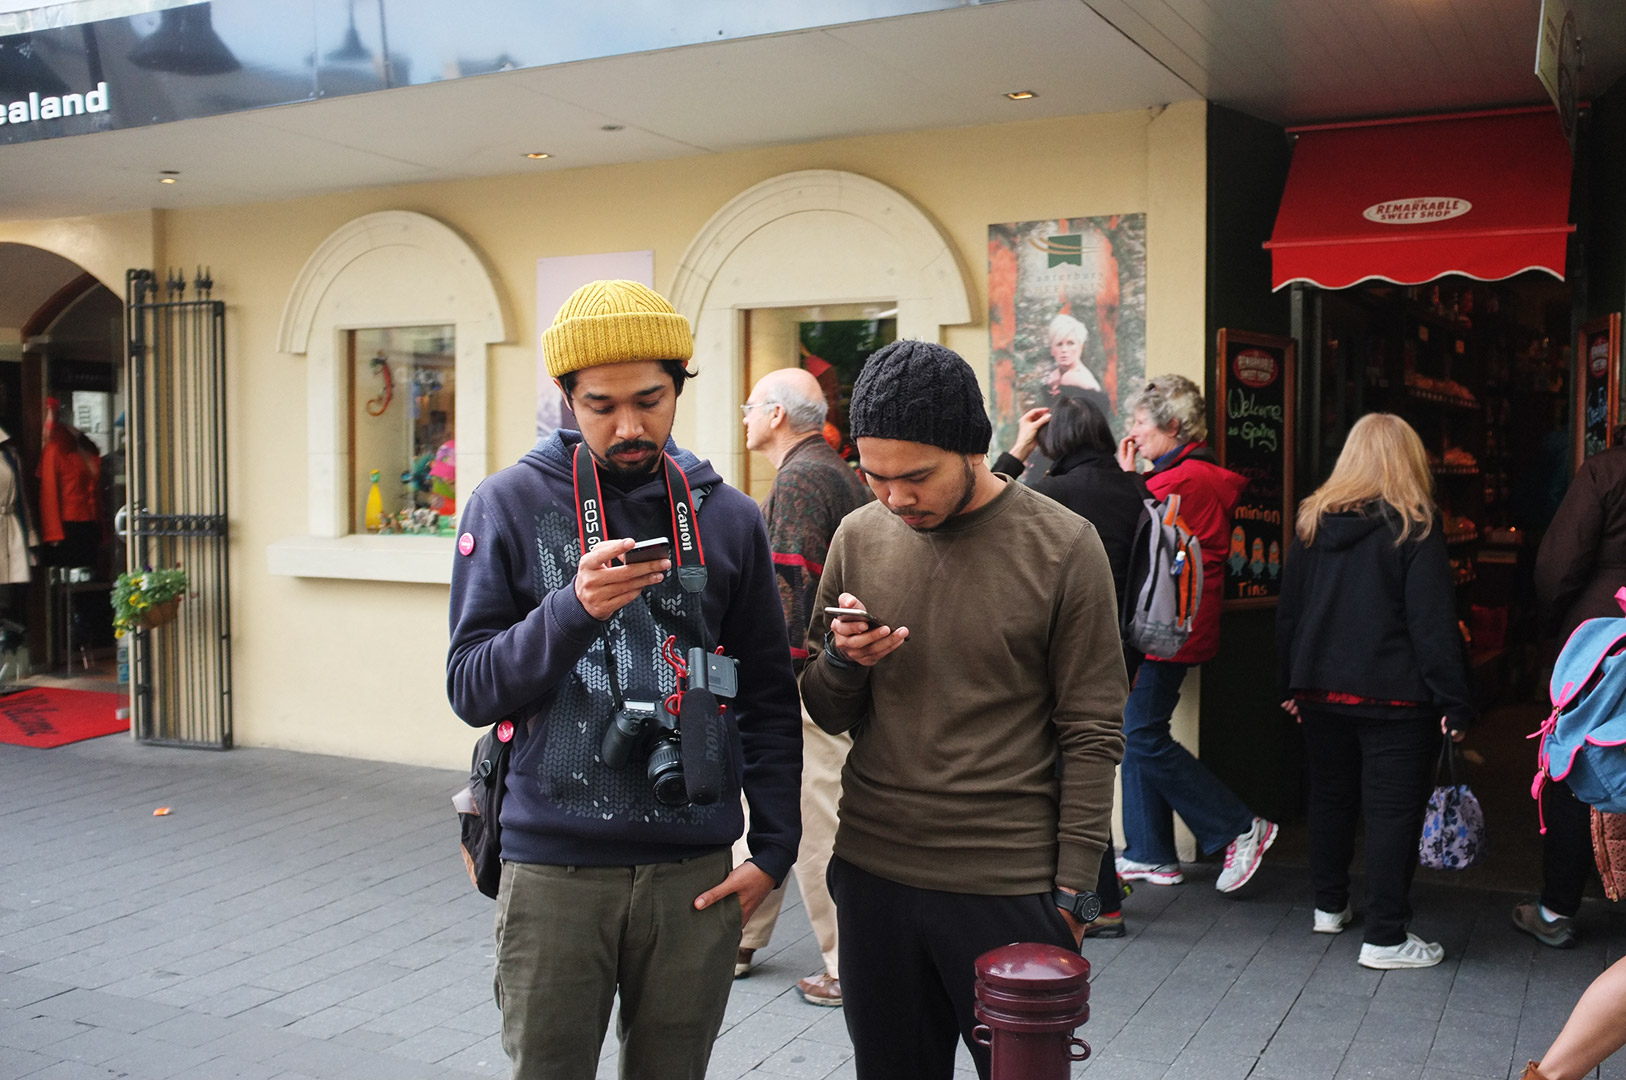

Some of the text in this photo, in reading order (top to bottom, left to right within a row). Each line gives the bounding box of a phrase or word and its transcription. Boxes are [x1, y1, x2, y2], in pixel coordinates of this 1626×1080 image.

[1376, 200, 1459, 215] REMARKABLE
[1381, 210, 1451, 221] SWEET SHOP
[1227, 388, 1283, 422] Welcome
[583, 499, 599, 534] EOS
[676, 501, 693, 551] Canon
[1238, 580, 1268, 598] Tins
